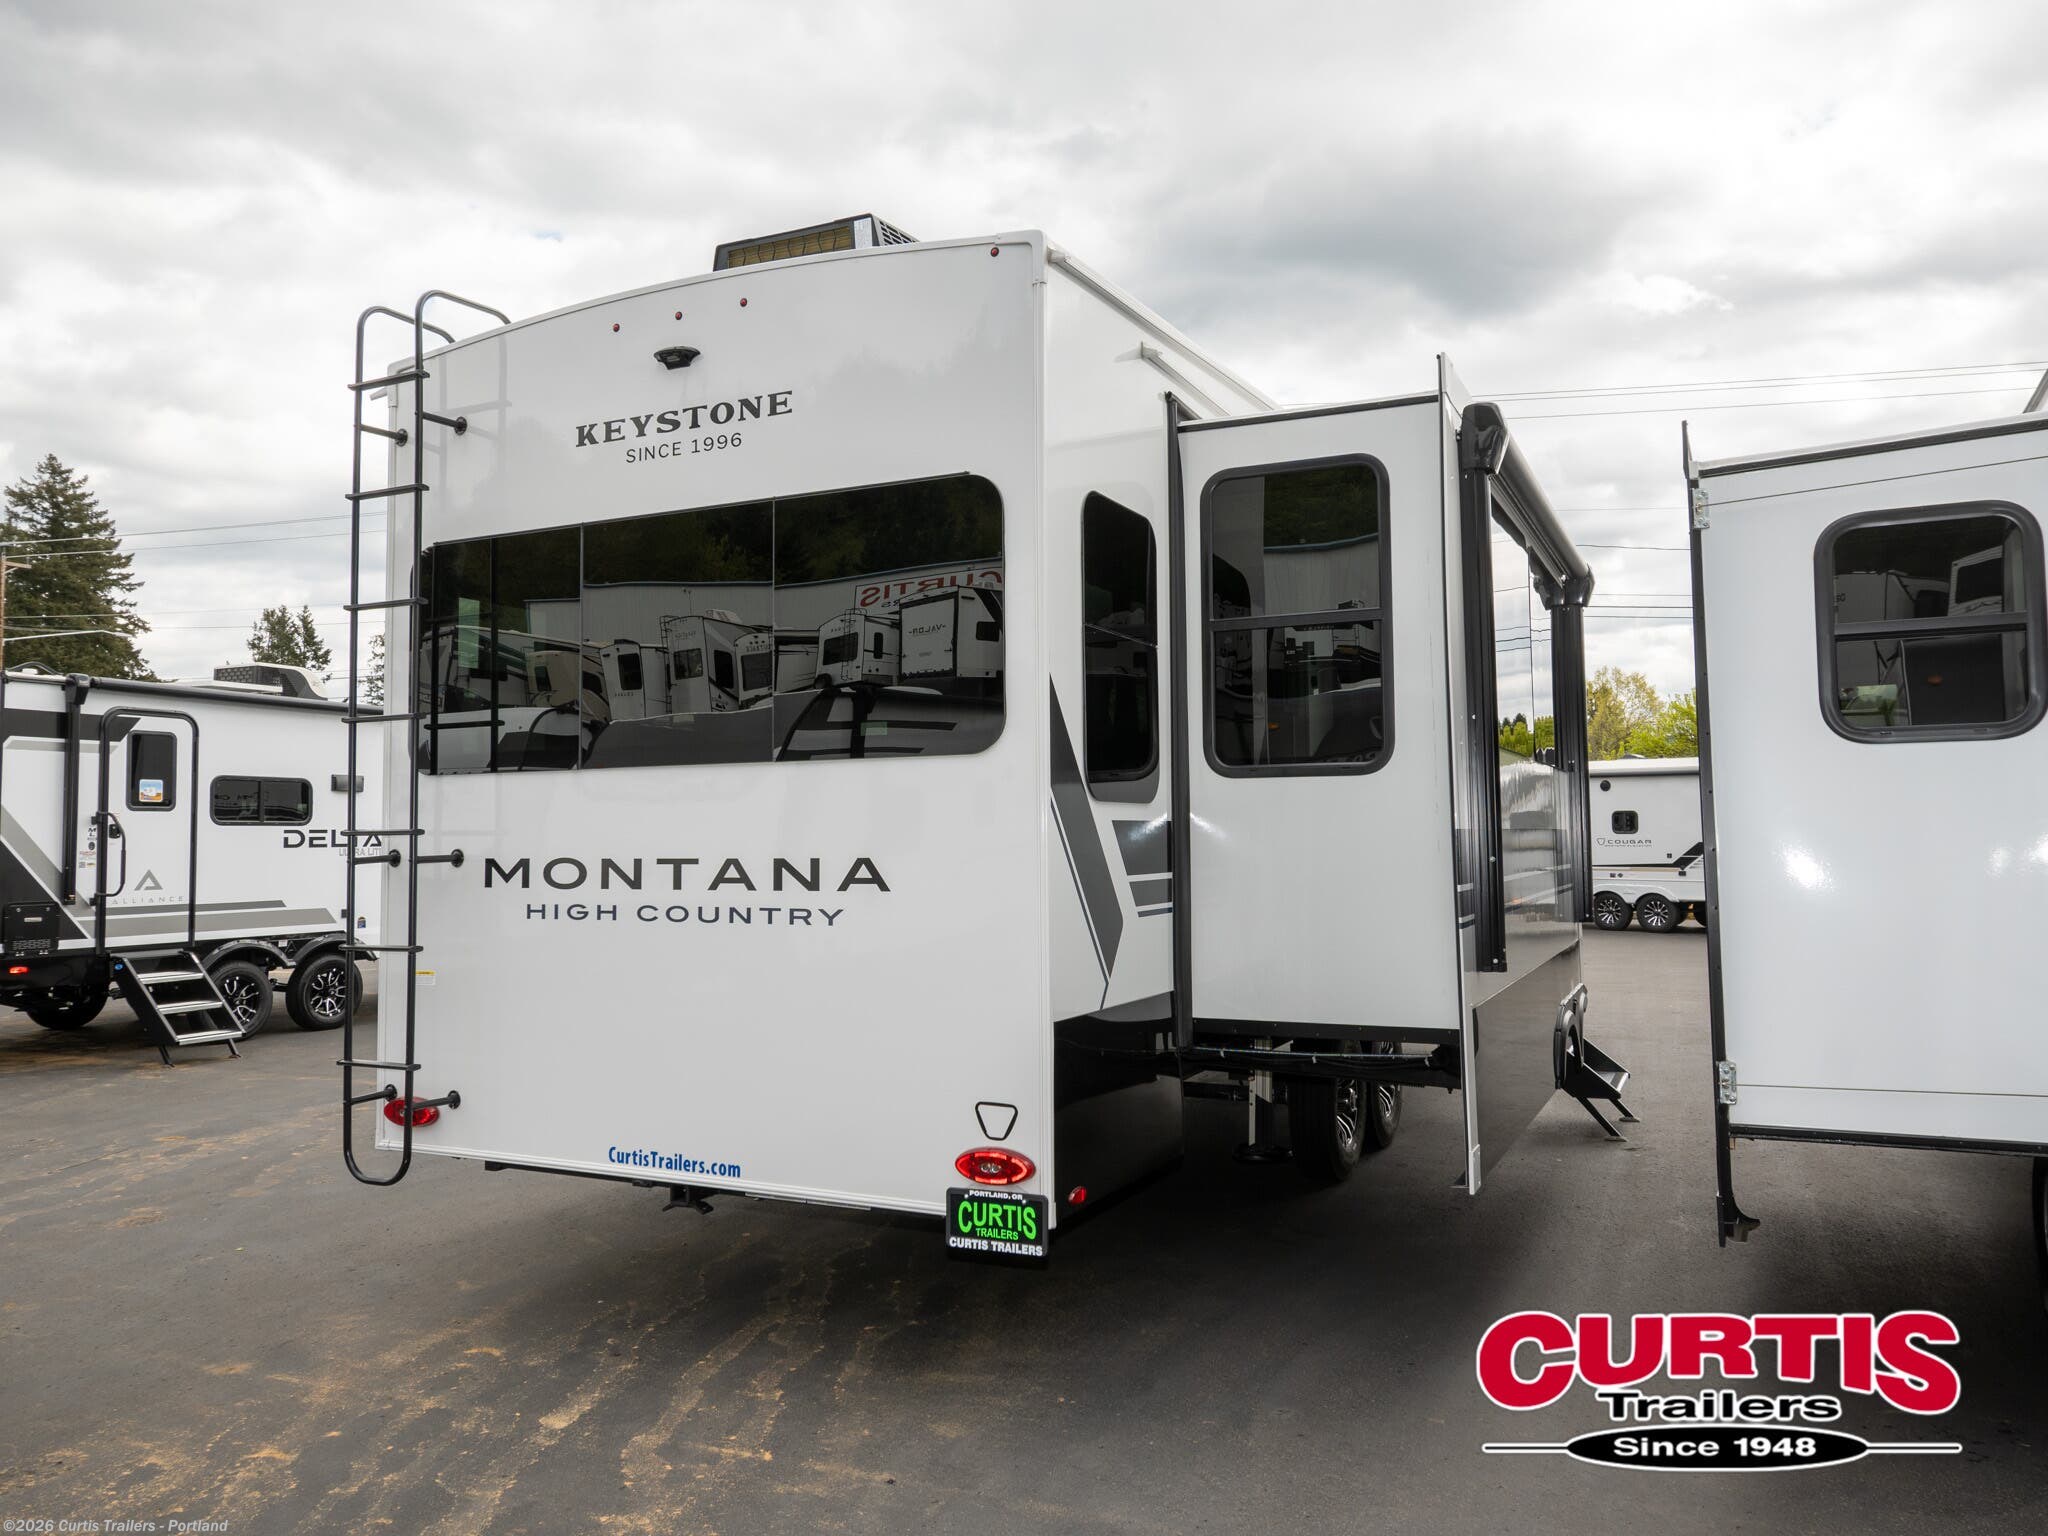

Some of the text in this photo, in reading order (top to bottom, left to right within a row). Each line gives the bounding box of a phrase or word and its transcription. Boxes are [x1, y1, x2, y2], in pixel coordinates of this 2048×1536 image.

[575, 390, 793, 447] KEYSTONE
[625, 432, 742, 463] SINCE 1996
[283, 829, 382, 848] DELA
[484, 857, 891, 892] MONTANA
[111, 896, 183, 904] ALLIANCE
[526, 903, 844, 927] HIGH COUNTRY
[608, 1146, 741, 1178] CurtisTrailers.com
[969, 1190, 1011, 1200] PORTLAND,
[958, 1201, 1037, 1240] CURTIS
[976, 1228, 1019, 1241] TRAILERS
[949, 1237, 1043, 1257] CURTIS TRAILERS
